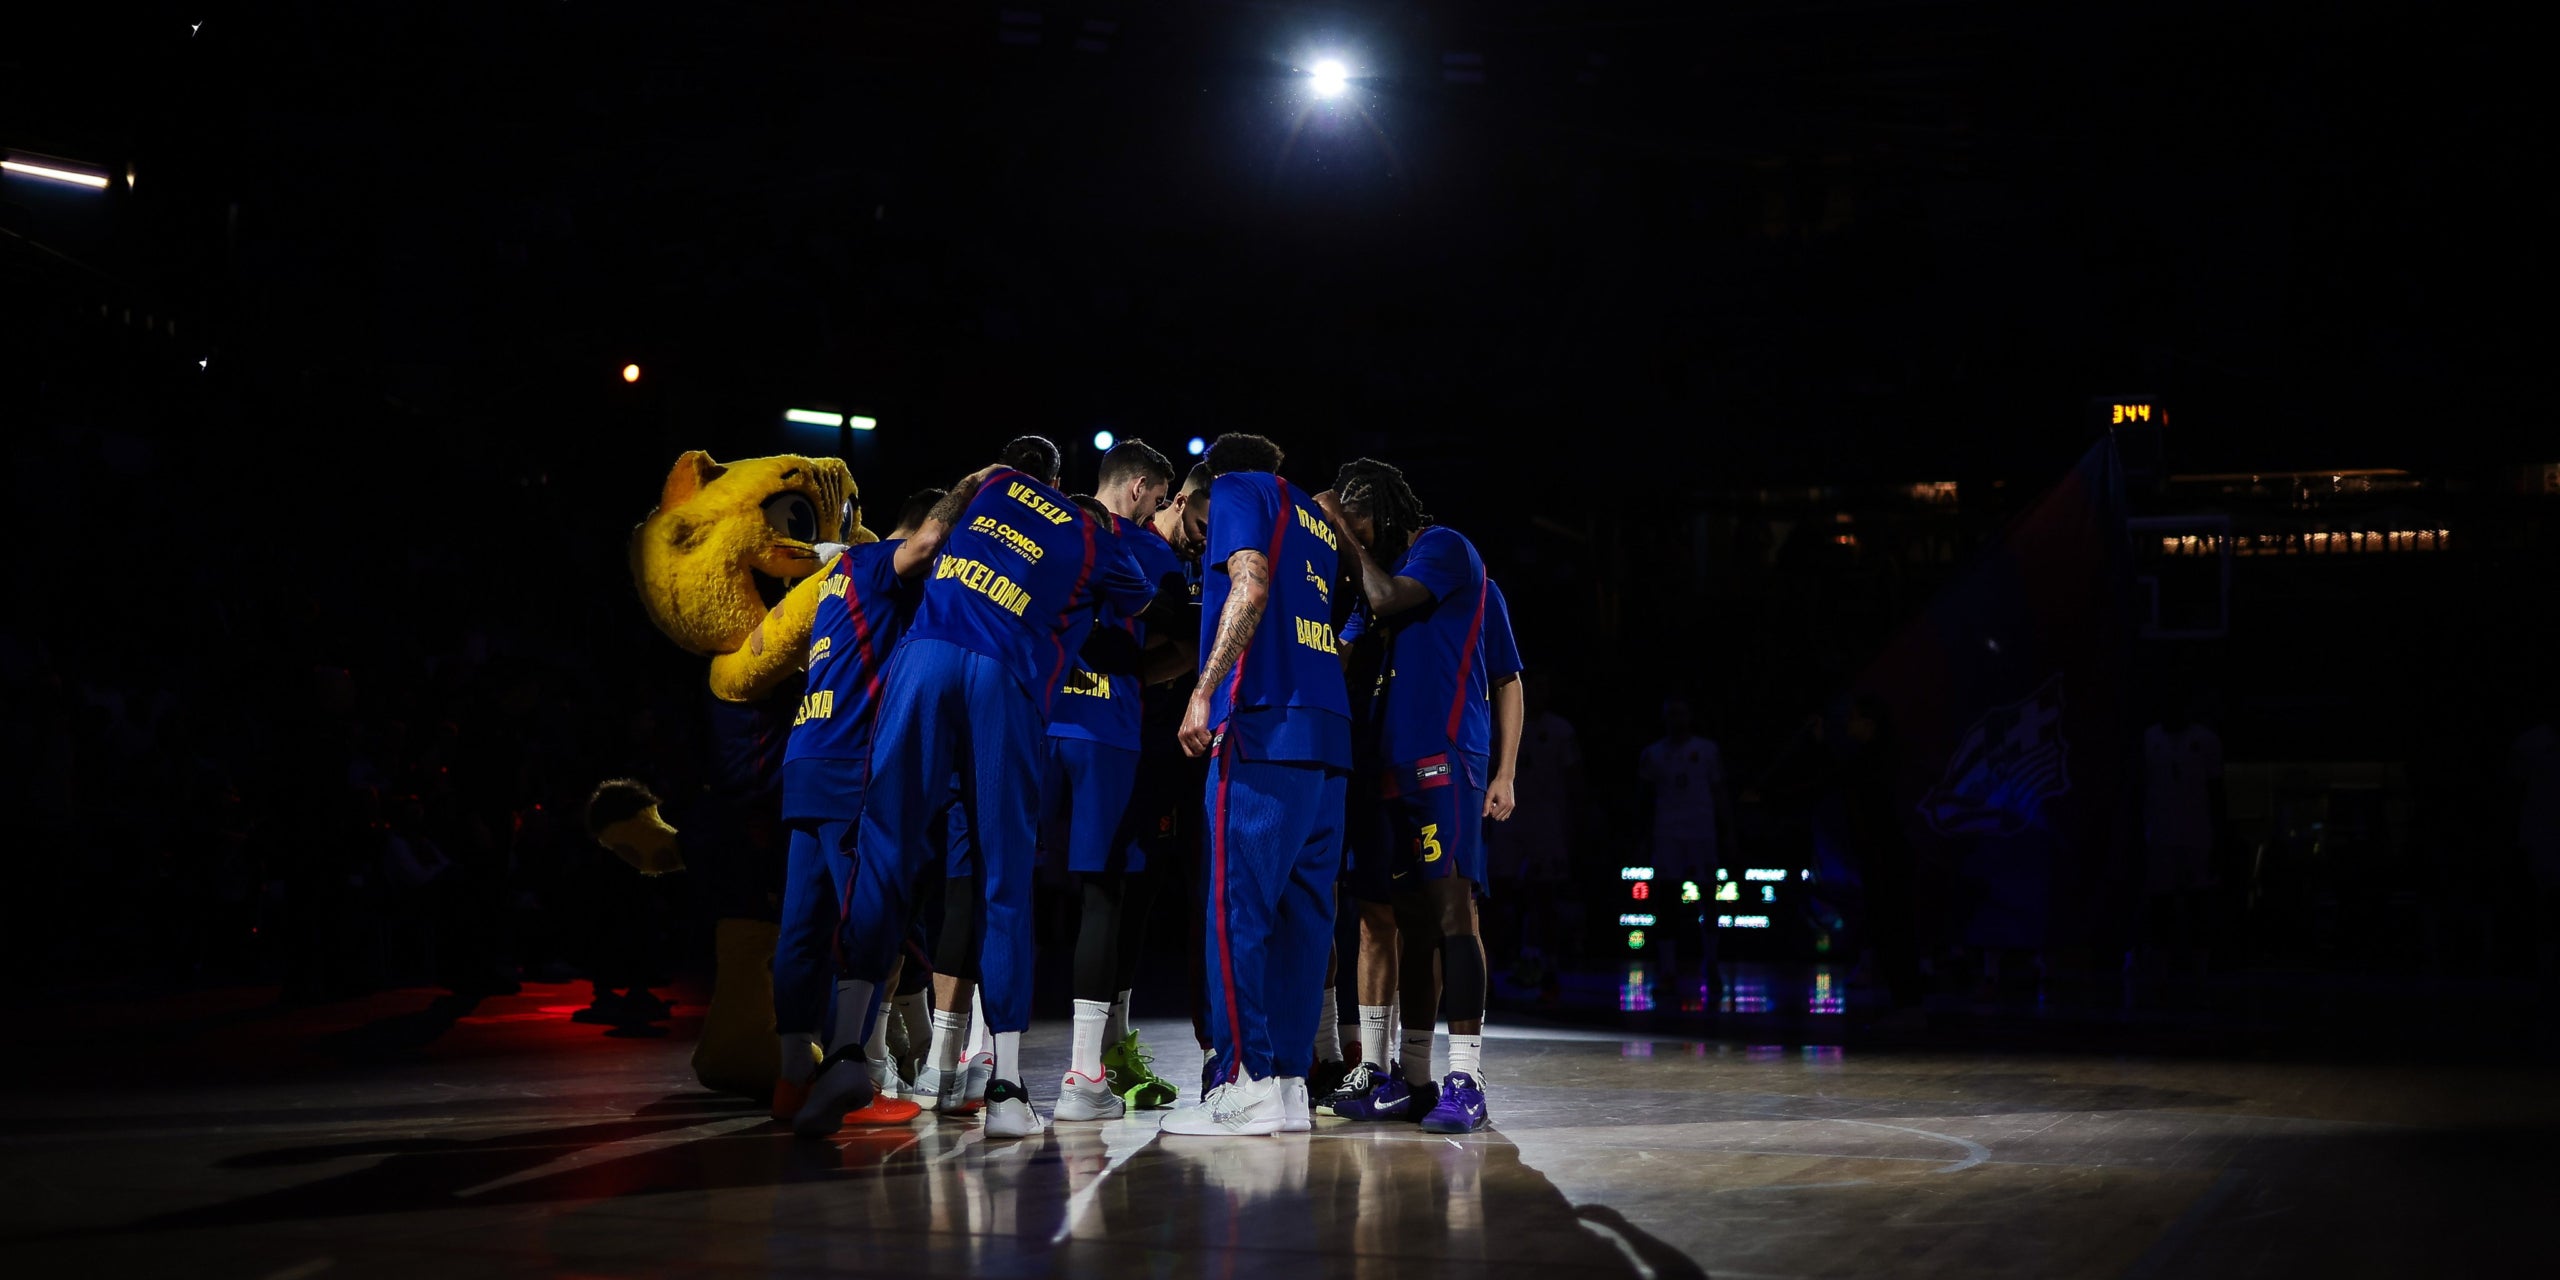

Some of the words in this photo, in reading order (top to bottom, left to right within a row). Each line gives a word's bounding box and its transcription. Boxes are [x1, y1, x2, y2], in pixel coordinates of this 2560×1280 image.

[1006, 481, 1073, 525] VESELY
[973, 515, 998, 530] R.D.
[996, 523, 1045, 560] CONGO
[989, 531, 1001, 540] DE
[1000, 537, 1038, 566] L'AFRIQUE
[1295, 615, 1339, 656] BARCE
[1421, 823, 1442, 862] 3
